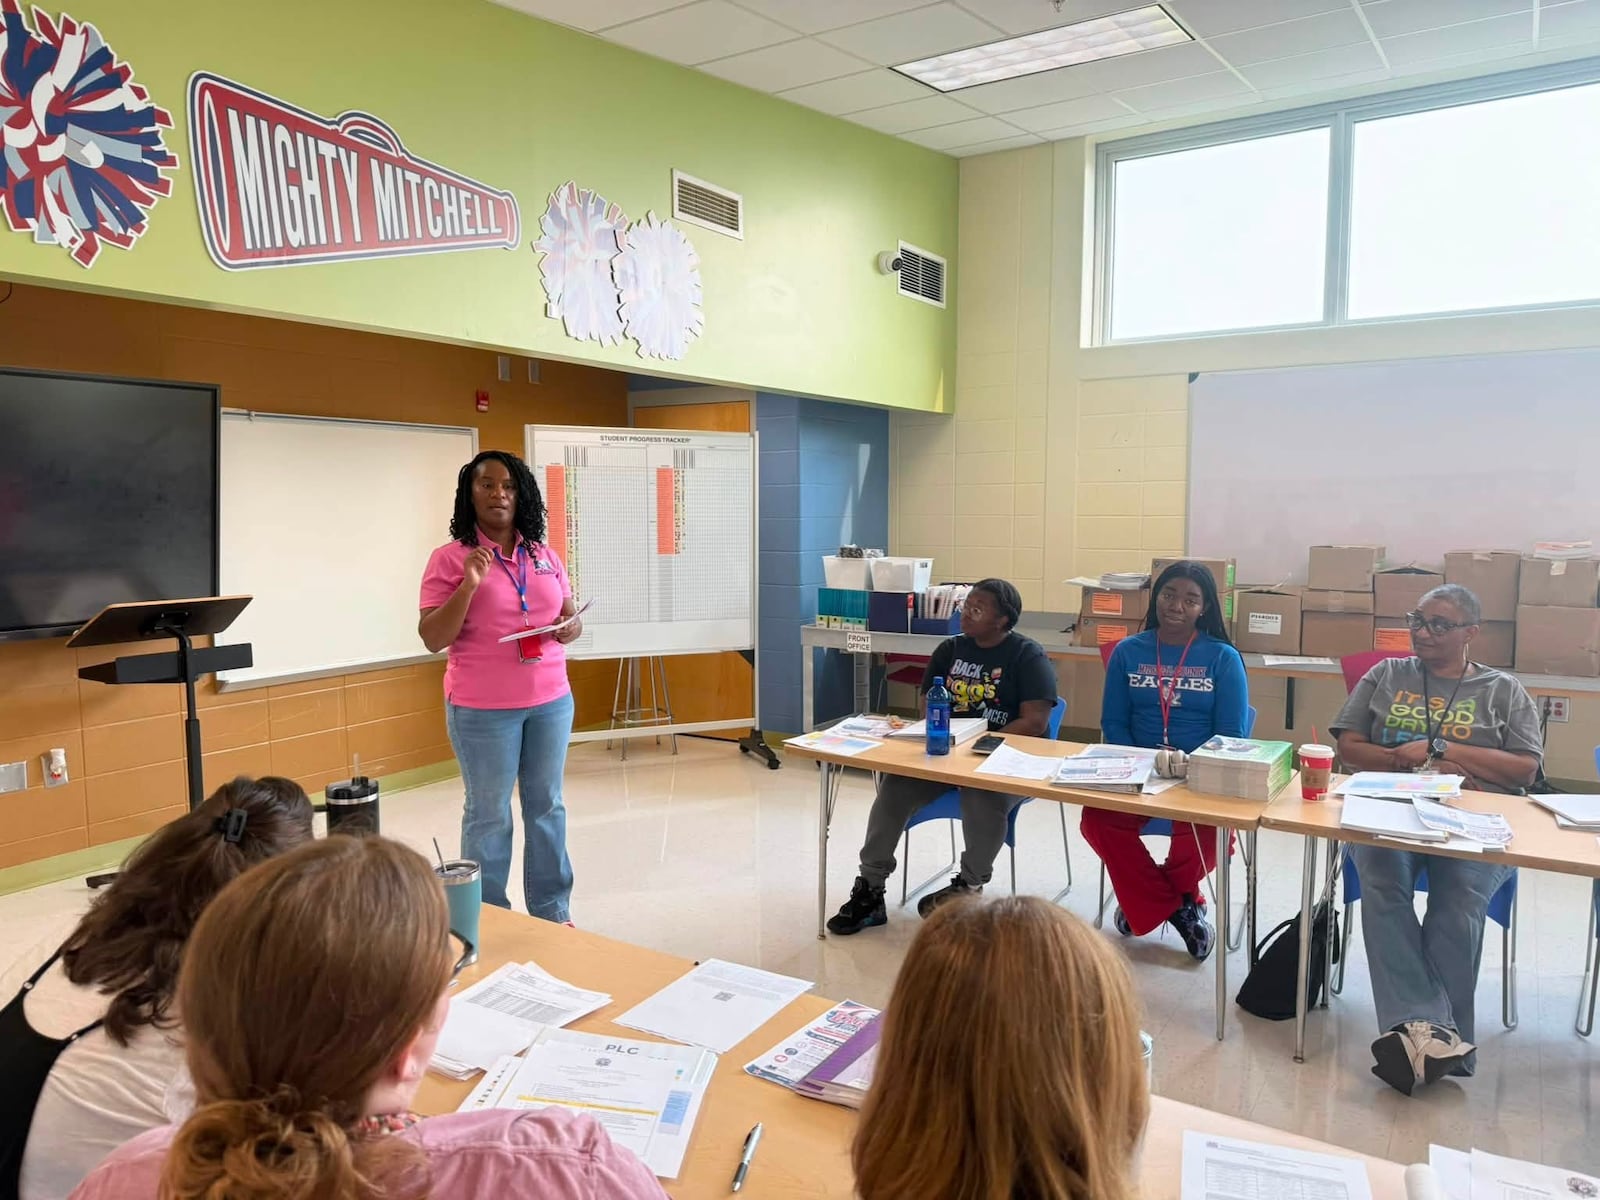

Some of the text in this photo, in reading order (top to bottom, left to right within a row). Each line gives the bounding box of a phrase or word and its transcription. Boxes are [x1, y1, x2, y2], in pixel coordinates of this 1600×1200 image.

[226, 107, 503, 250] MIGHTY MITCHELL
[629, 435, 661, 443] PROGRESS
[848, 634, 869, 643] FRONT
[848, 642, 870, 651] OFFICE
[950, 658, 984, 679] BACK
[1127, 673, 1214, 692] EAGLES
[1390, 704, 1475, 725] GOOD
[1456, 698, 1476, 714] A
[982, 707, 1009, 726] MCES
[1385, 715, 1472, 740] DAY TO
[605, 1044, 640, 1055] PLC
